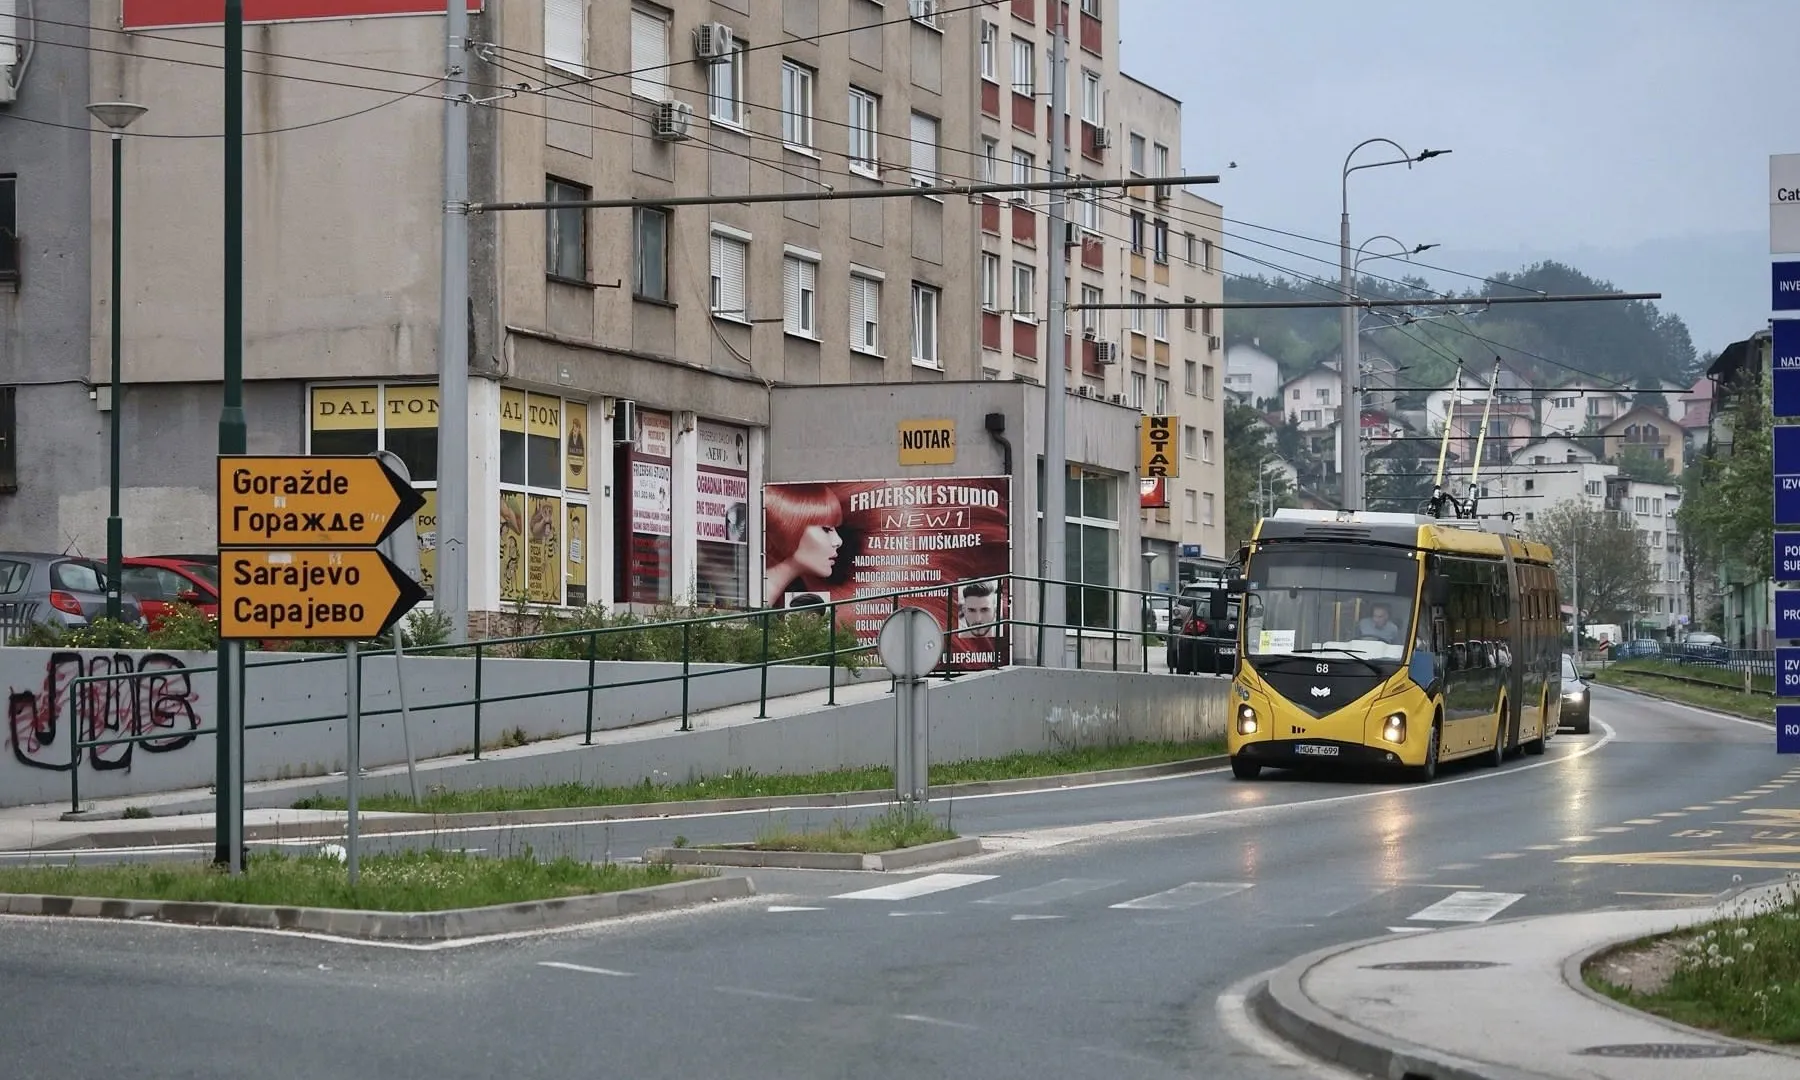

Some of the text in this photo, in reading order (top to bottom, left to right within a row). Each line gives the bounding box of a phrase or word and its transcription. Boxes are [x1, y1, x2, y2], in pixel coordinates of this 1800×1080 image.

[902, 429, 951, 450] NOTAR
[1148, 416, 1169, 478] NOTAR
[233, 468, 349, 495] Goražde
[1783, 477, 1800, 489] IZV
[850, 485, 999, 512] FRIZERSKI STUDIO
[233, 506, 364, 538] Горажде
[885, 511, 964, 529] NEW 1
[868, 533, 981, 551] ZA ŽENE I MUŠKARCE
[1785, 545, 1800, 556] PO
[910, 554, 929, 565] KOSE
[233, 559, 360, 592] Sarajevo
[910, 570, 941, 582] NOKTIJU
[234, 596, 364, 629] Сарајево
[1315, 663, 1329, 673] 68
